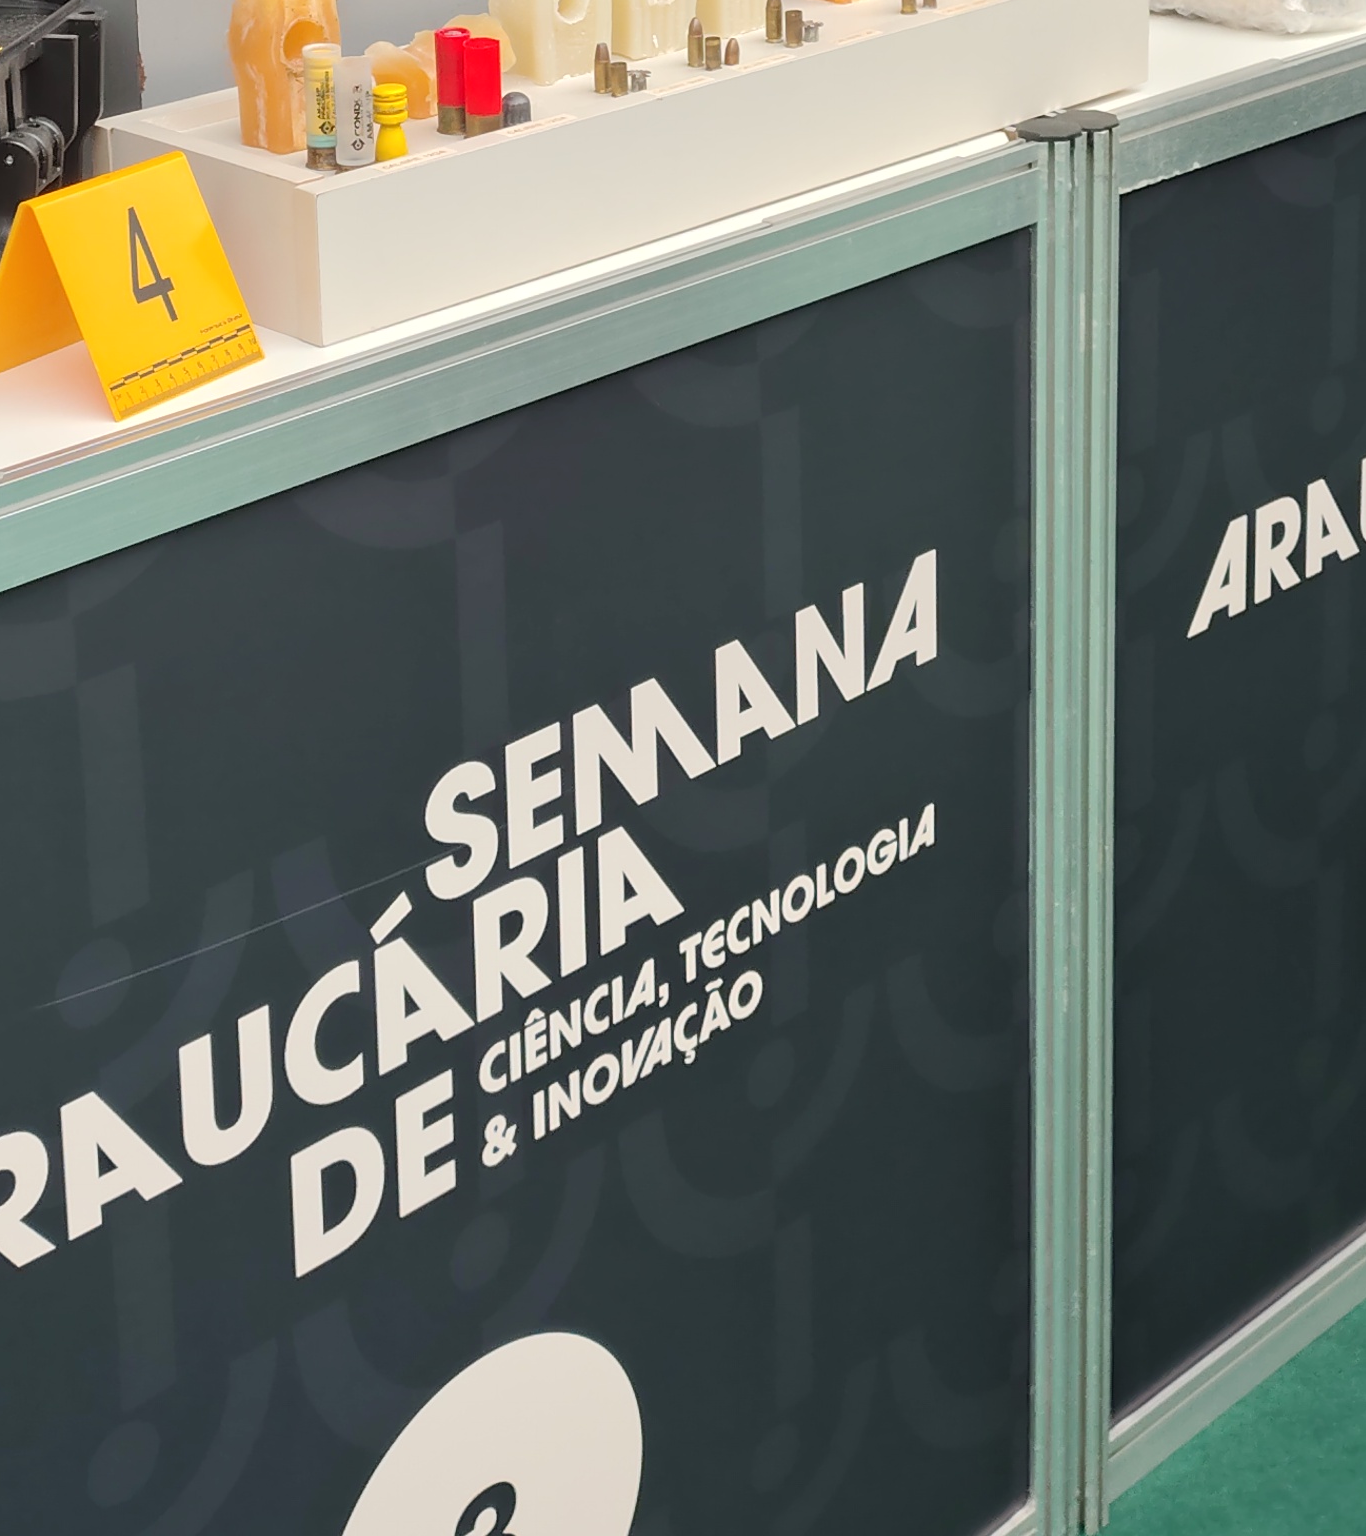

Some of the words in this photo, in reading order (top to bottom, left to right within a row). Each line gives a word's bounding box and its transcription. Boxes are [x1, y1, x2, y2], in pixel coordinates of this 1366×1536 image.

[127, 206, 179, 322] 4
[424, 548, 937, 901] SEMANA
[478, 957, 670, 1093] CIÊNCIA,
[679, 803, 935, 983] TECNOLOGIA
[481, 1114, 517, 1167] &
[534, 970, 763, 1140] INOVAÇÃO
[290, 1069, 457, 1279] DE
